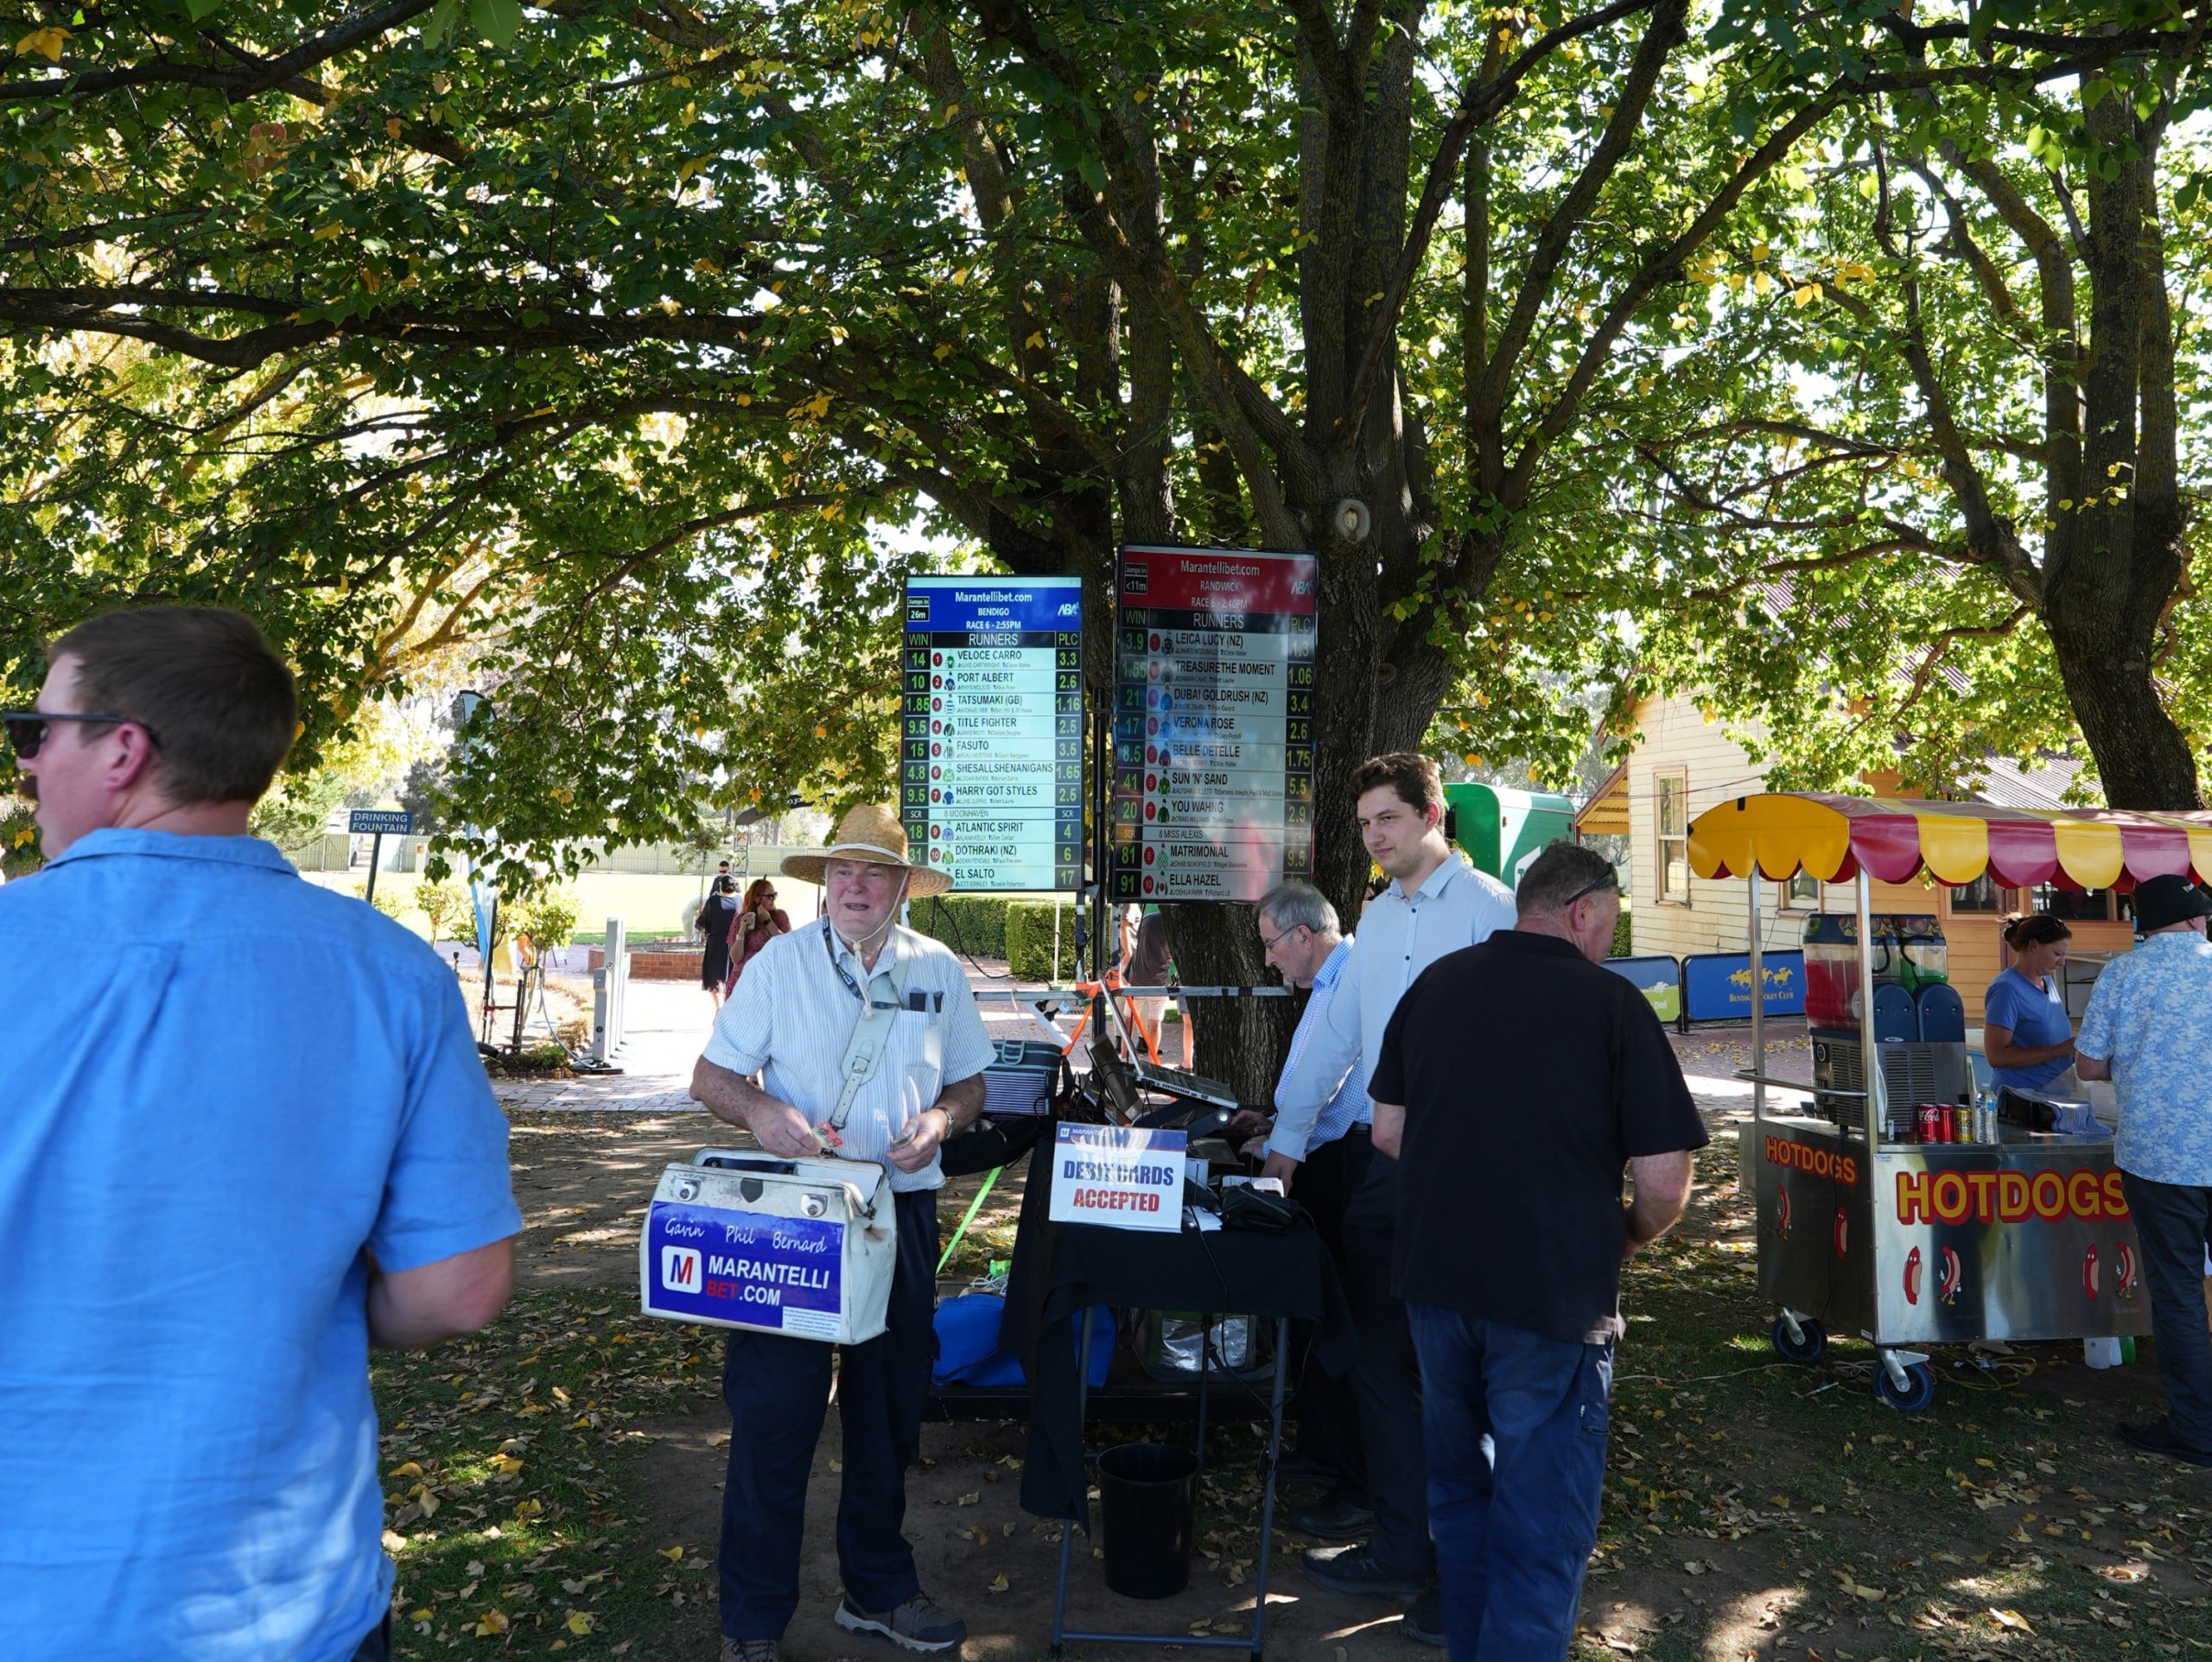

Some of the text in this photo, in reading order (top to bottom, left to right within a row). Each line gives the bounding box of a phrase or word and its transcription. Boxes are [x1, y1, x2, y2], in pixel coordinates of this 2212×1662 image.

[1126, 567, 1141, 575] Jumps
[1180, 560, 1260, 576] Marantellibet.com
[1200, 580, 1240, 593] RANDWICK
[955, 591, 1033, 602] Marantellibet.com
[1191, 597, 1210, 607] RACE
[1211, 598, 1217, 607] 6
[1222, 598, 1248, 609] 2:40PM
[911, 610, 926, 619] 26m
[977, 607, 1009, 616] BENDIGO
[1125, 609, 1146, 625] WIN
[966, 620, 985, 630] RACE
[985, 620, 990, 630] 6
[995, 620, 1021, 630] 2:55PM
[1193, 612, 1244, 629] RUNNERS
[1291, 617, 1311, 632] PLC
[908, 633, 929, 646] WIN
[969, 633, 1019, 646] RUNNERS
[1058, 632, 1078, 646] PLC
[1126, 632, 1143, 650] 3.9
[1175, 632, 1243, 648] LEICA LUCY (NZ)
[957, 650, 1022, 660] VELOCE CARRO
[1292, 640, 1309, 657] 1.3
[912, 652, 926, 666] 14
[935, 656, 940, 664] 1
[1059, 652, 1077, 666] 3.3
[1239, 663, 1275, 676] MOMENT
[1288, 667, 1312, 684] 1.06
[912, 675, 925, 689] 10
[935, 677, 940, 686] 2
[957, 672, 1014, 682] PORT ALBERT
[1059, 675, 1077, 688] 2.6
[957, 695, 1023, 706] TATSUMAKI (GB)
[1126, 688, 1139, 706] 21
[1174, 688, 1268, 705] DUBAI GOLDRUSH (NZ)
[1291, 695, 1308, 712] 3.4
[906, 697, 930, 712] 1.85
[934, 700, 940, 708] 3
[1056, 697, 1080, 711] 1.16
[908, 720, 926, 734] 9.5
[934, 723, 940, 732] 4
[957, 717, 1017, 727] TITLE FIGHTER
[1059, 719, 1077, 733] 2.5
[1126, 717, 1140, 734] 17
[1173, 716, 1235, 730] VERONA ROSE
[1290, 722, 1307, 739] 2.6
[910, 743, 925, 758] 15
[933, 745, 939, 754] 5
[957, 740, 989, 751] FASUTO
[1059, 743, 1077, 757] 3.5
[1173, 745, 1240, 758] BELLE DETELLE
[1122, 745, 1141, 762] 8.5
[1287, 750, 1310, 767] 1.75
[907, 765, 925, 780] 4.8
[956, 763, 1053, 773] SHESALLSHENANIGANS
[1056, 765, 1080, 779] 1.65
[1124, 773, 1137, 790] 41
[1172, 772, 1190, 784] SUN
[1204, 773, 1228, 785] SAND
[956, 785, 1038, 796] HARRY GOT STYLES
[1288, 777, 1306, 795] 5.5
[907, 788, 925, 802] 9.5
[1059, 788, 1077, 802] 2.5
[1062, 809, 1073, 818] SCR
[1123, 802, 1138, 819] 20
[1147, 807, 1154, 815] 7
[1172, 800, 1224, 813] YOU WAHNG
[1288, 805, 1306, 822] 2.9
[353, 813, 408, 822] DRINKING
[910, 809, 922, 819] SCR
[352, 822, 408, 832] FOUNTAIN
[909, 825, 923, 840] 18
[956, 822, 1024, 832] ATLANTIC SPIRIT
[1064, 824, 1071, 838] 4
[1123, 828, 1135, 838] SCR
[1159, 829, 1203, 839] 8 MISS ALEXIS
[909, 847, 922, 862] 31
[931, 851, 939, 860] 10
[956, 845, 1017, 857] DOTHRAKI (NZ)
[1064, 847, 1071, 861] 6
[1121, 846, 1135, 864] 81
[1170, 845, 1229, 858] MATRIMONIAL
[1287, 849, 1306, 867] 9.5
[955, 868, 995, 879] EL SALTO
[1061, 870, 1074, 885] 17
[1170, 873, 1221, 886] ELLA HAZEL
[1121, 875, 1135, 892] 91
[1145, 879, 1153, 889] 10
[1765, 1136, 1857, 1184] HOTDOGS
[1064, 1160, 1173, 1186] DEBIT CARDS
[1073, 1188, 1160, 1213] ACCEPTED
[1898, 1170, 2131, 1221] HOTDOGS
[665, 1217, 828, 1253] Gavin Phil Bernard
[670, 1254, 694, 1285] M
[708, 1255, 830, 1290] MARANTELLI
